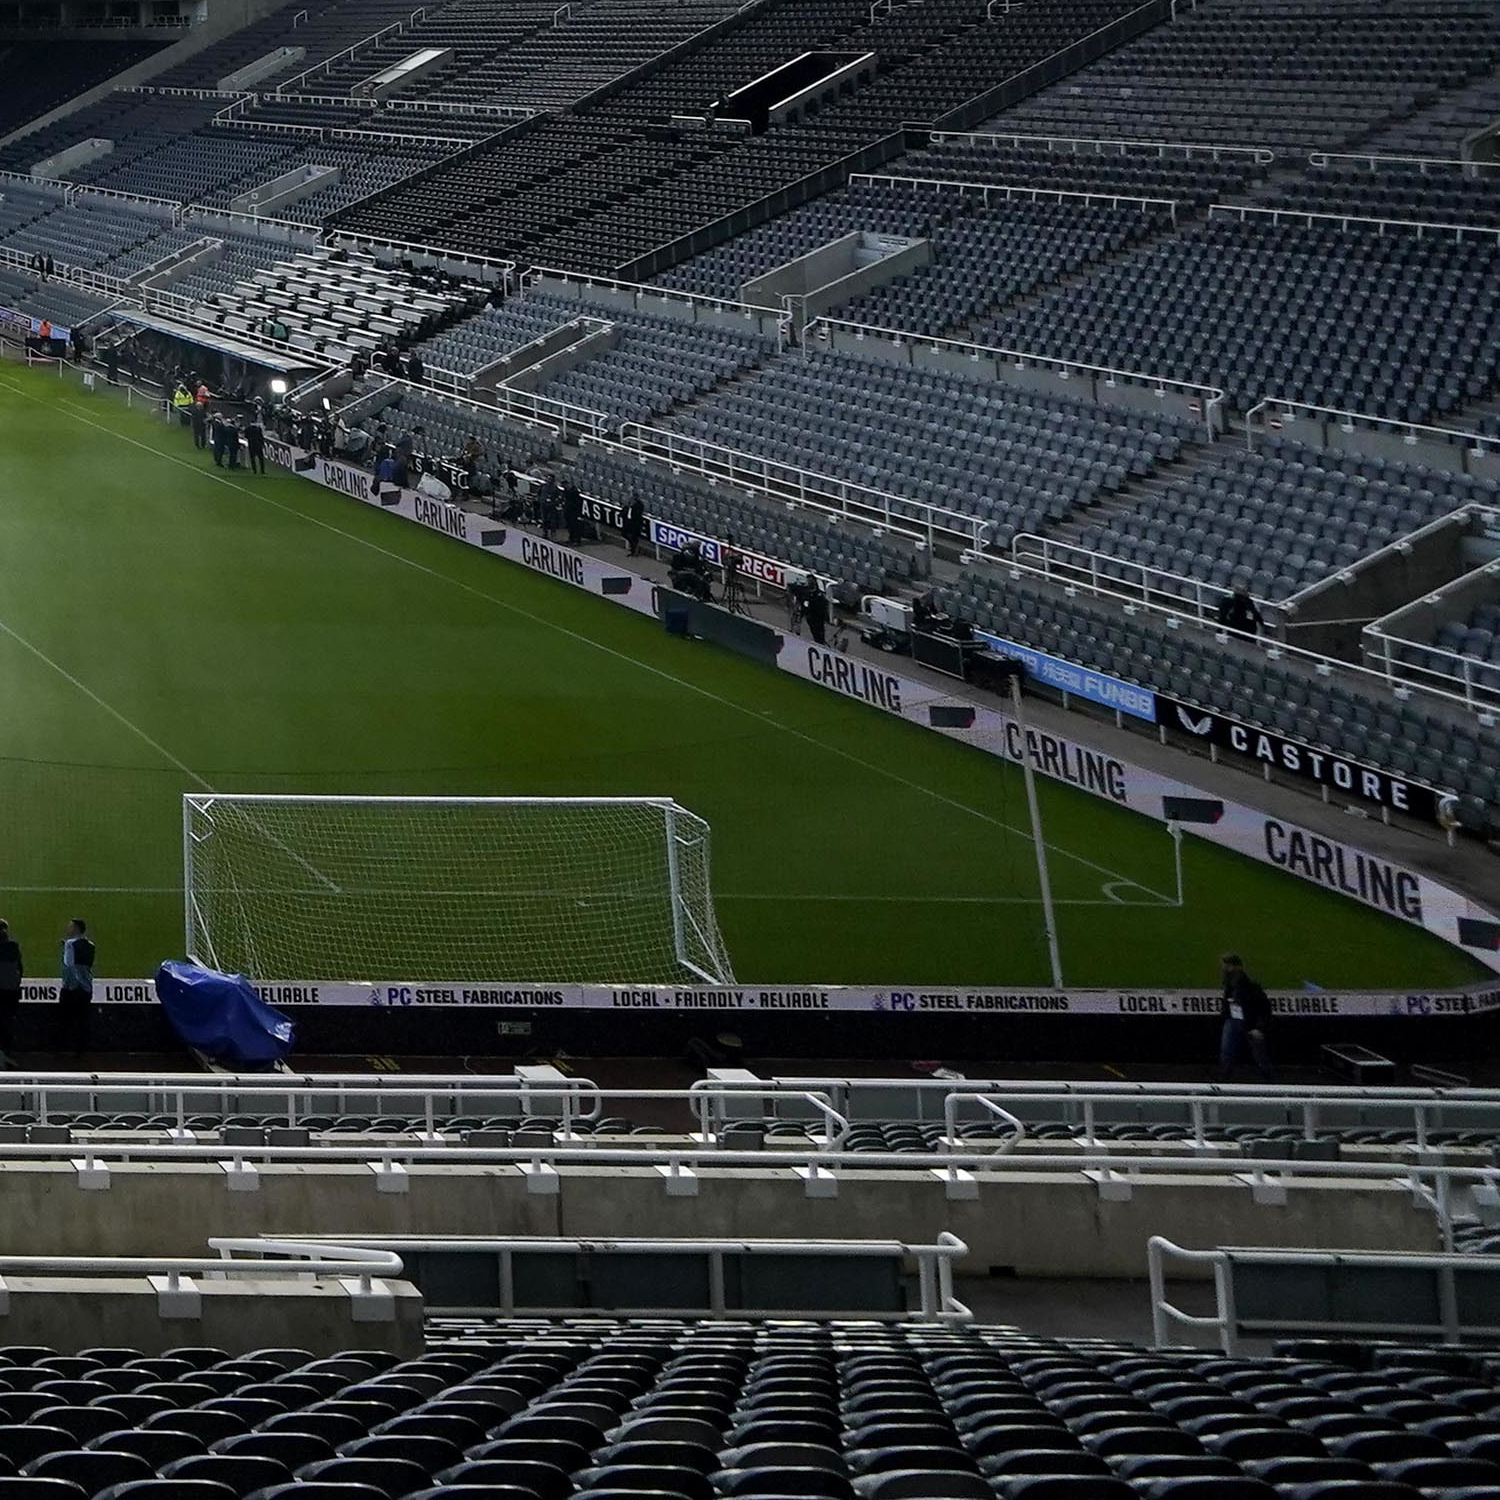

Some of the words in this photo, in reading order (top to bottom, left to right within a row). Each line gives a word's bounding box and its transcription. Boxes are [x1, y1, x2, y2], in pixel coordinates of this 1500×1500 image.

[323, 460, 369, 500] CARLING
[415, 496, 467, 538] CARLING
[522, 537, 584, 586] CARLING
[660, 527, 716, 560] SPOTS
[808, 646, 902, 712] CARLING
[1006, 722, 1128, 803] CARLING
[1230, 725, 1409, 810] CASTORE
[1265, 820, 1424, 921] CARLING
[106, 986, 152, 1002] LOCAL
[388, 988, 411, 1005] PC
[416, 990, 458, 1004] STEEL
[463, 990, 563, 1006] FABRICATIONS
[613, 991, 659, 1007] LOCAL
[675, 991, 743, 1008] FRIENDLY
[761, 992, 829, 1009] RELIABLE
[891, 993, 914, 1010] PC
[920, 994, 963, 1009] STEEL
[967, 995, 1069, 1011] FABRICATIONS
[1120, 996, 1166, 1012] LOCAL
[1407, 996, 1431, 1013] PC
